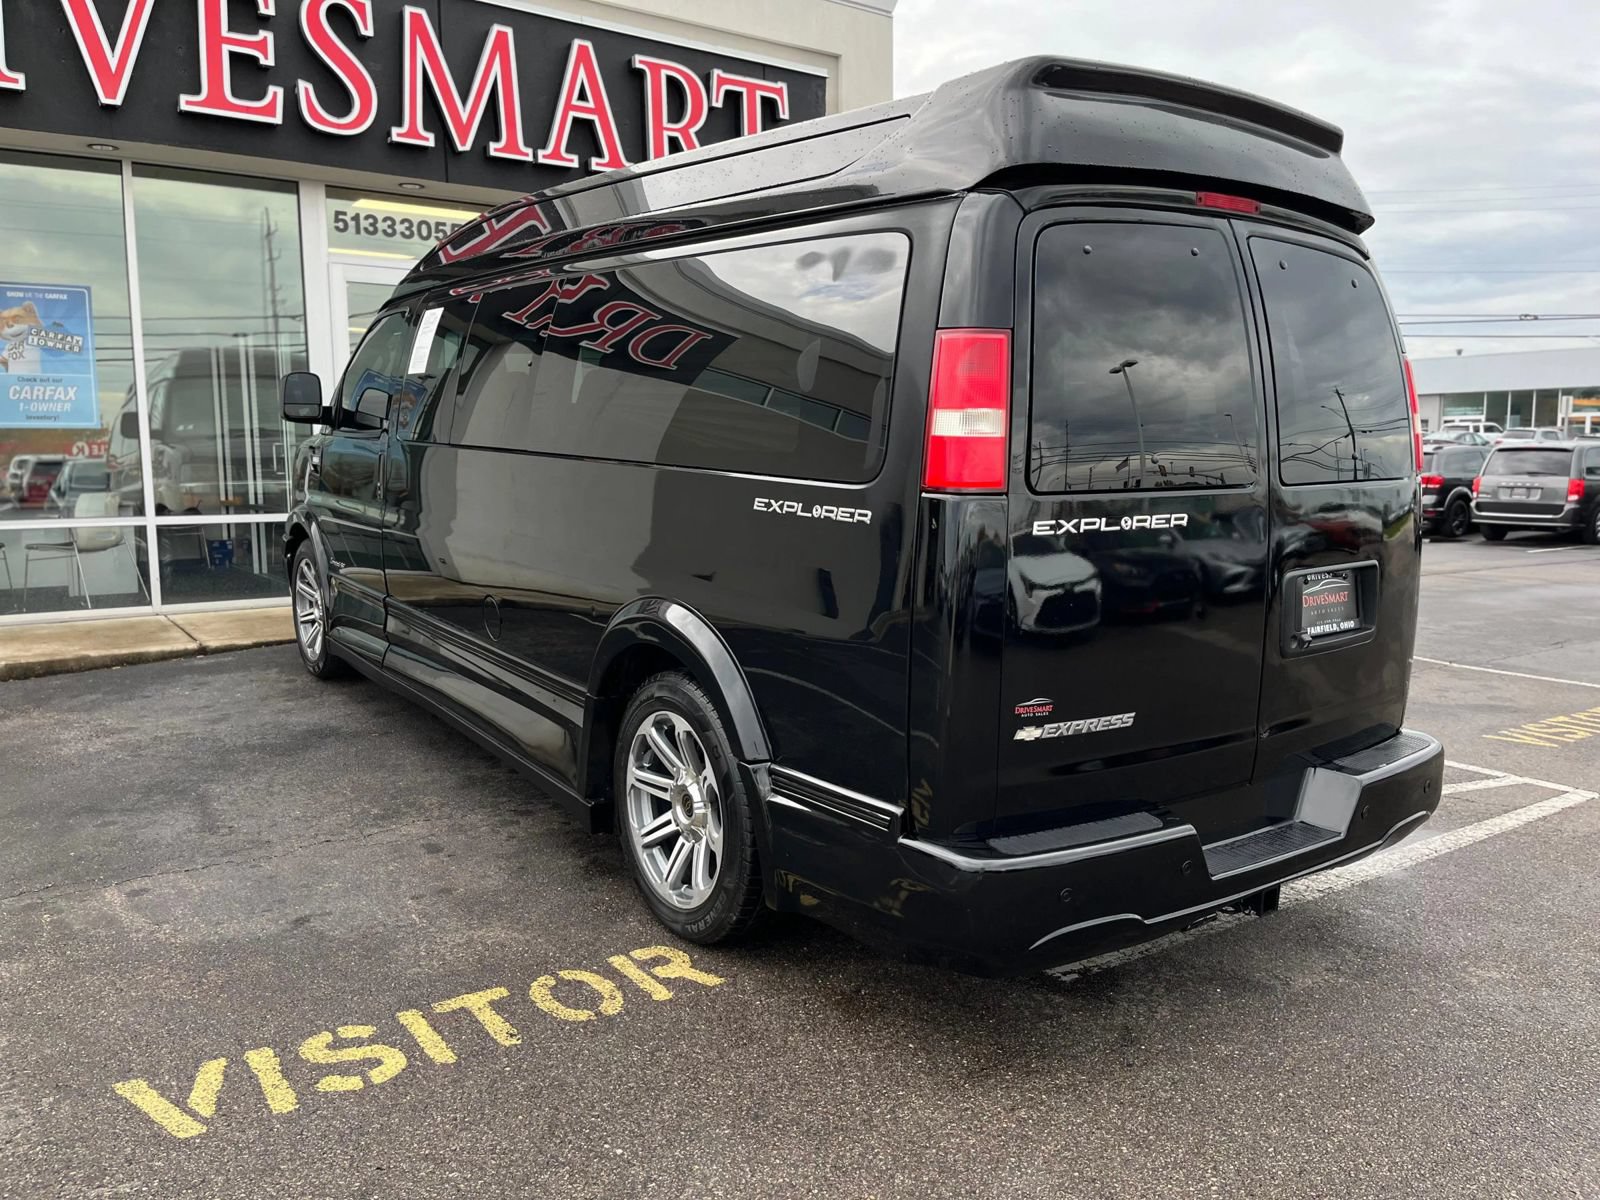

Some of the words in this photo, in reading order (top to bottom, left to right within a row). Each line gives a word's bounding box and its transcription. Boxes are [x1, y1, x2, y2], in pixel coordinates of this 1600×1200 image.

[0, 0, 789, 170] VESMART
[30, 328, 83, 344] CARFAX
[9, 385, 77, 400] CARFAX
[19, 402, 72, 412] 1-OWNER
[753, 497, 872, 525] EXPLORER
[1032, 513, 1189, 536] EXPLORER
[1302, 591, 1349, 608] DRIVESMART
[1340, 620, 1355, 630] OHIO
[1015, 704, 1054, 714] DRIVESMART
[1041, 712, 1136, 739] EXPRESS
[685, 890, 727, 933] GENERAL
[114, 945, 726, 1139] VISITOR
